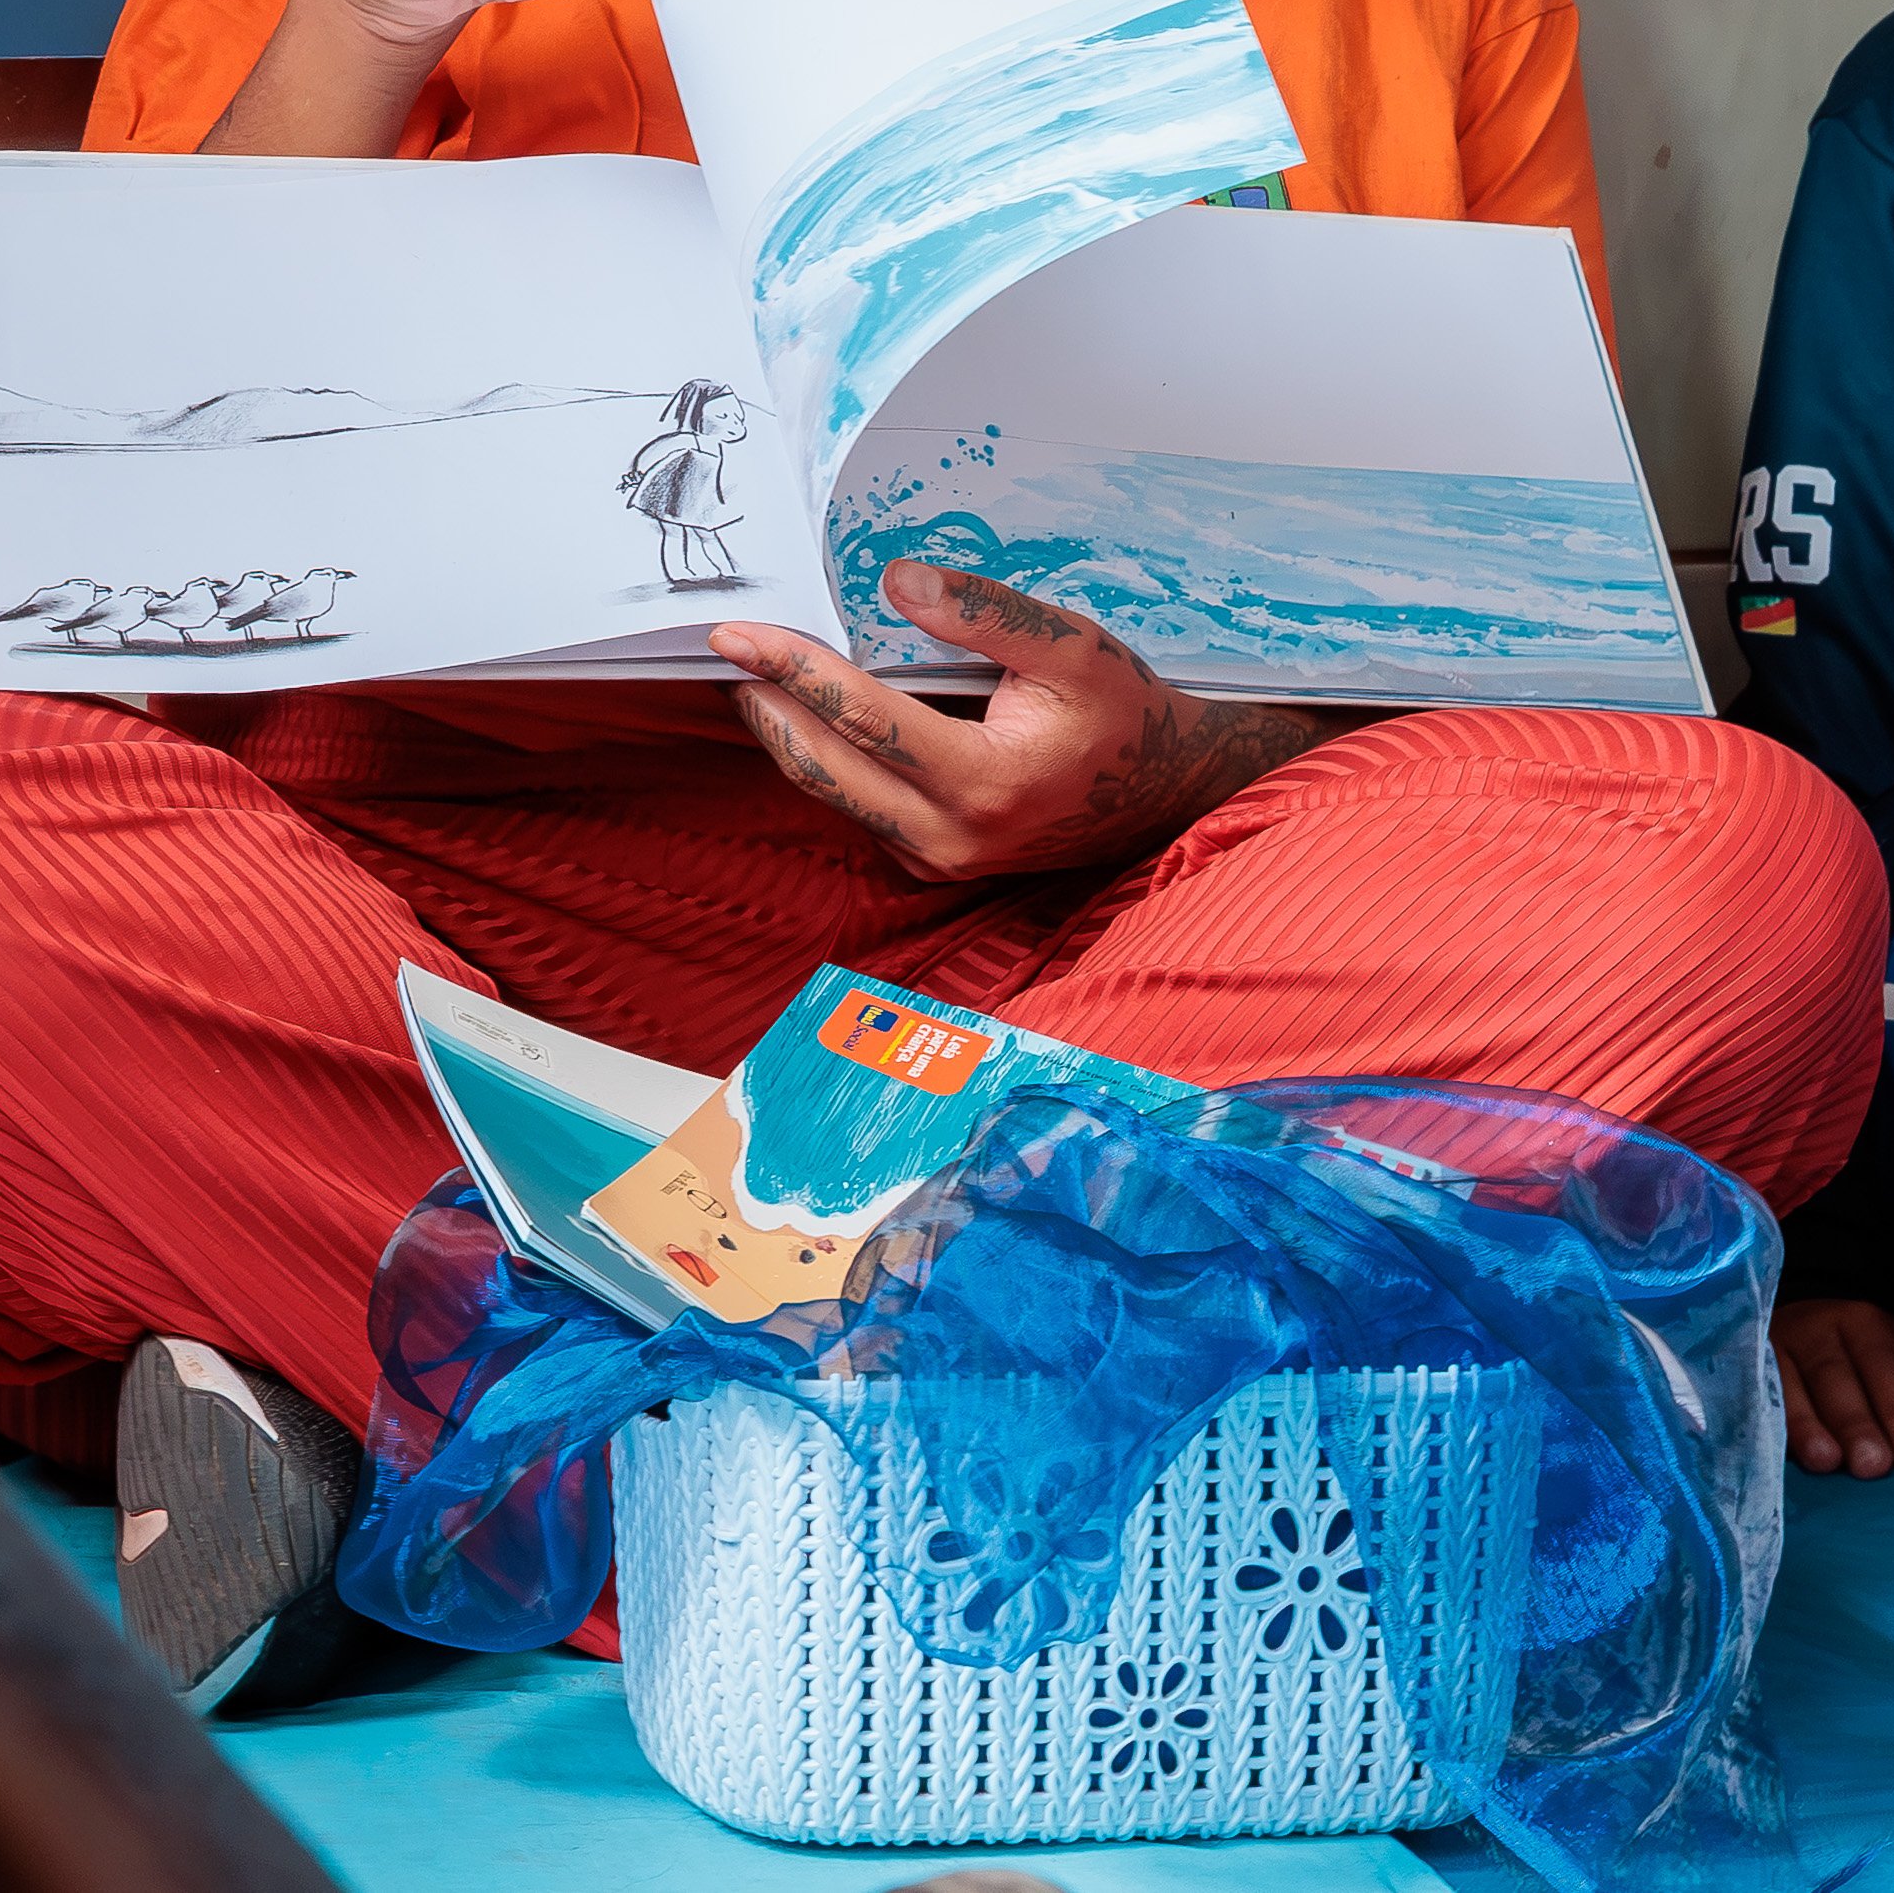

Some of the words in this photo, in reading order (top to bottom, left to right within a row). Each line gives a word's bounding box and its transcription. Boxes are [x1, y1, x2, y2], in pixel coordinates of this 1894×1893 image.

[1730, 464, 1836, 585] RS
[842, 1025, 869, 1052] Social
[895, 1023, 933, 1063] criança.
[923, 1028, 950, 1055] para
[939, 1035, 970, 1059] Leia
[906, 1053, 933, 1078] uma
